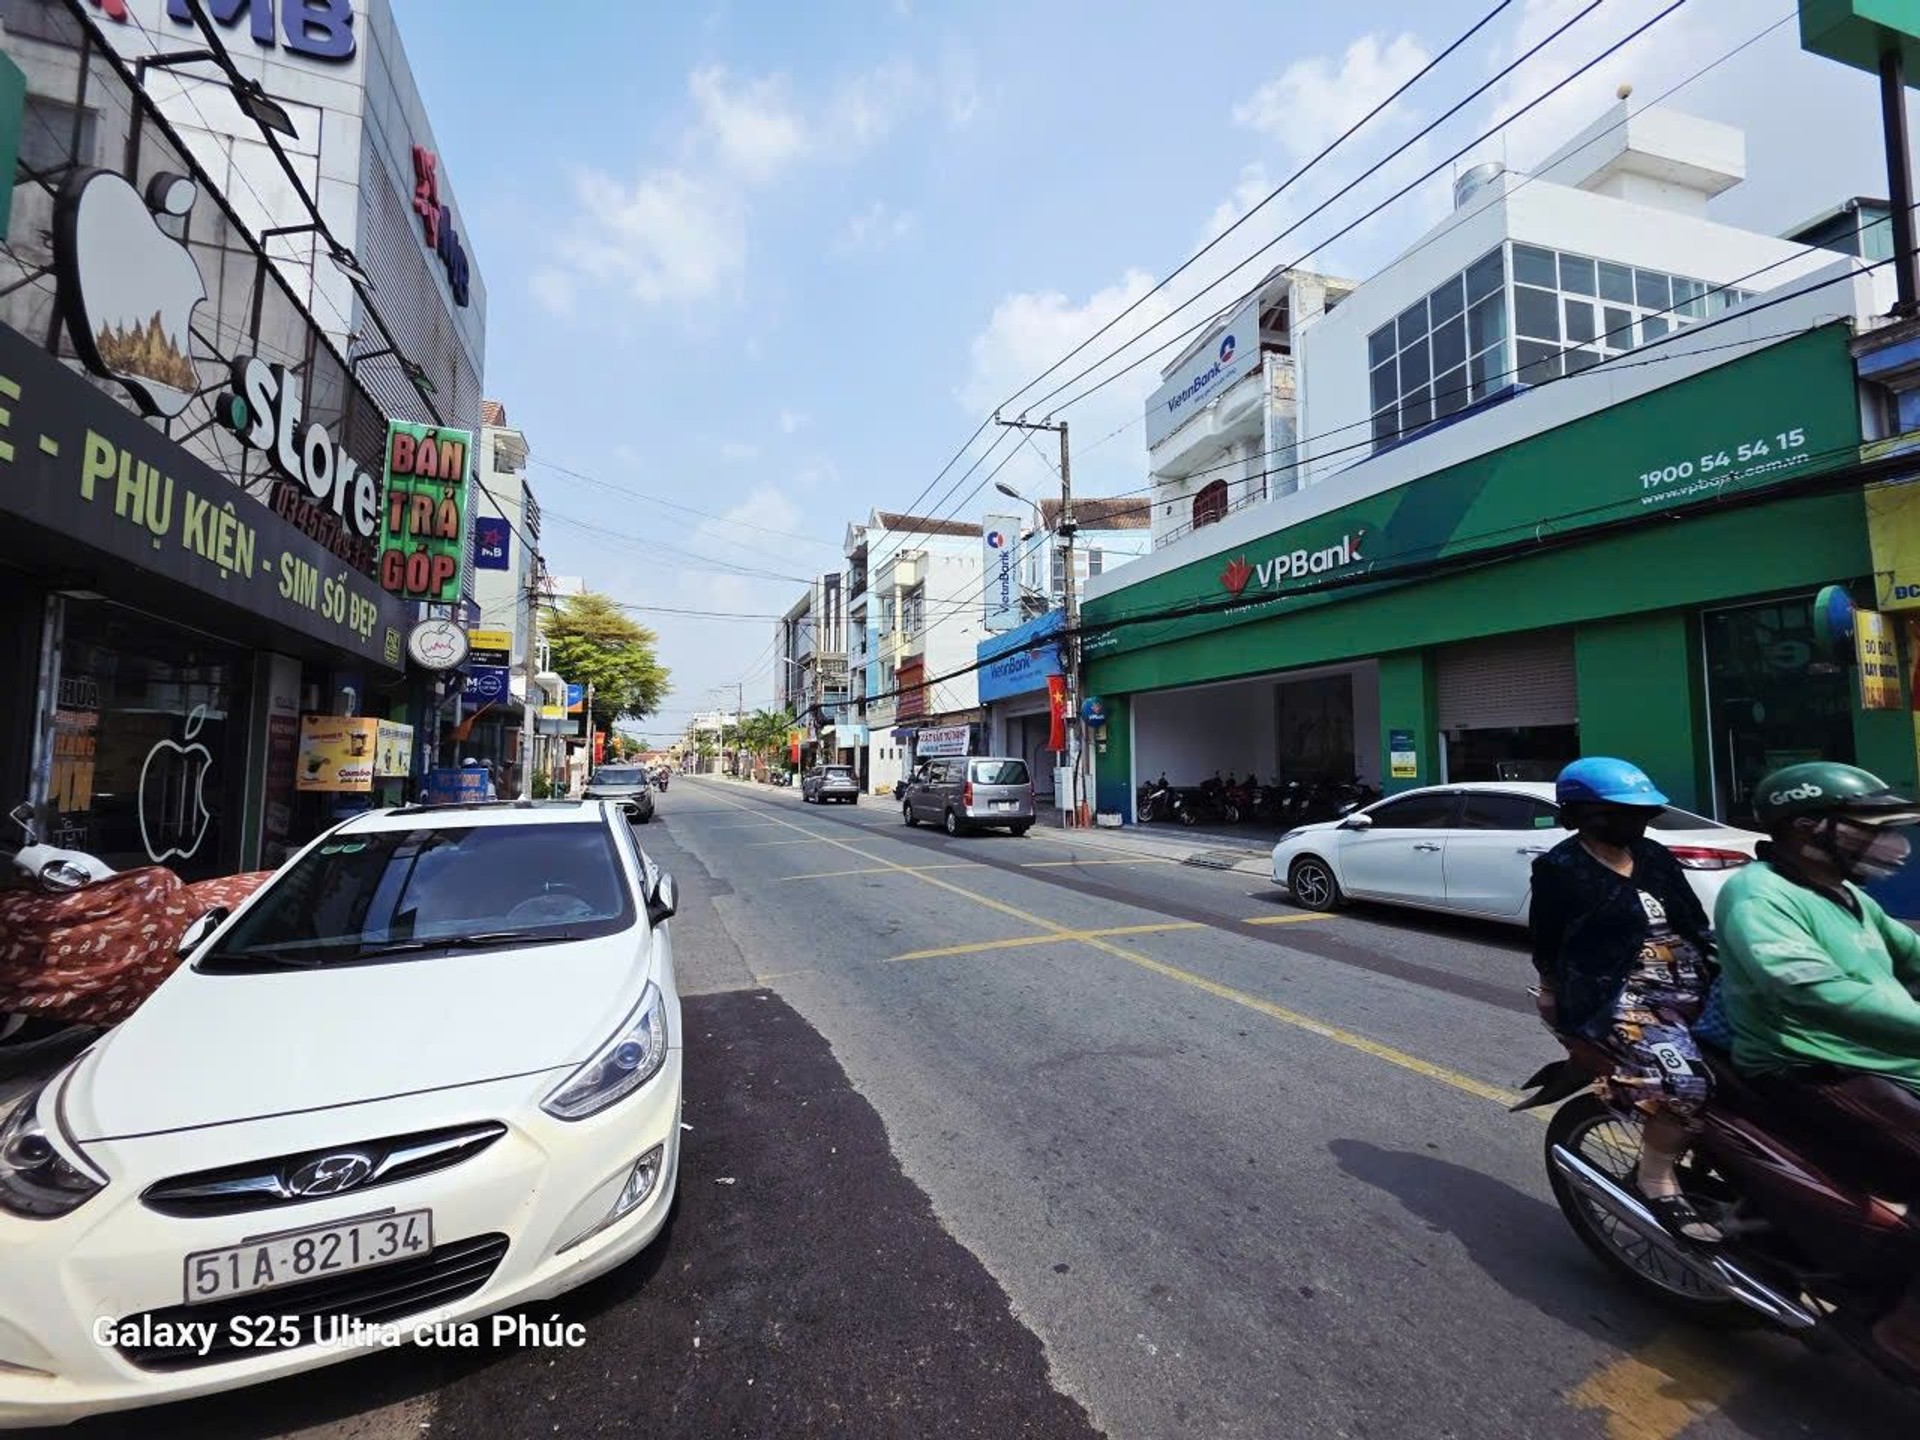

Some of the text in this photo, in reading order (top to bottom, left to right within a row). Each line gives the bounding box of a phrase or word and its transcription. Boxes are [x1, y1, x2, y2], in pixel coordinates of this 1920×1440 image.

[1168, 361, 1221, 413] VietinBank
[391, 429, 465, 482] BÁN
[1639, 427, 1806, 489] 1900 54 54 15
[80, 428, 174, 549] PHỤ
[183, 490, 256, 579] KIỆN
[279, 551, 318, 611] SIM
[321, 571, 347, 624] SỐ
[349, 591, 378, 643] ĐẸP
[388, 485, 459, 539] TRẢ
[381, 544, 456, 597] GÓP
[999, 550, 1010, 613] VietinBank
[1256, 529, 1366, 588] VPBank
[338, 769, 371, 777] Combo
[1769, 783, 1823, 806] Grab
[196, 1217, 423, 1295] 51A-821.34
